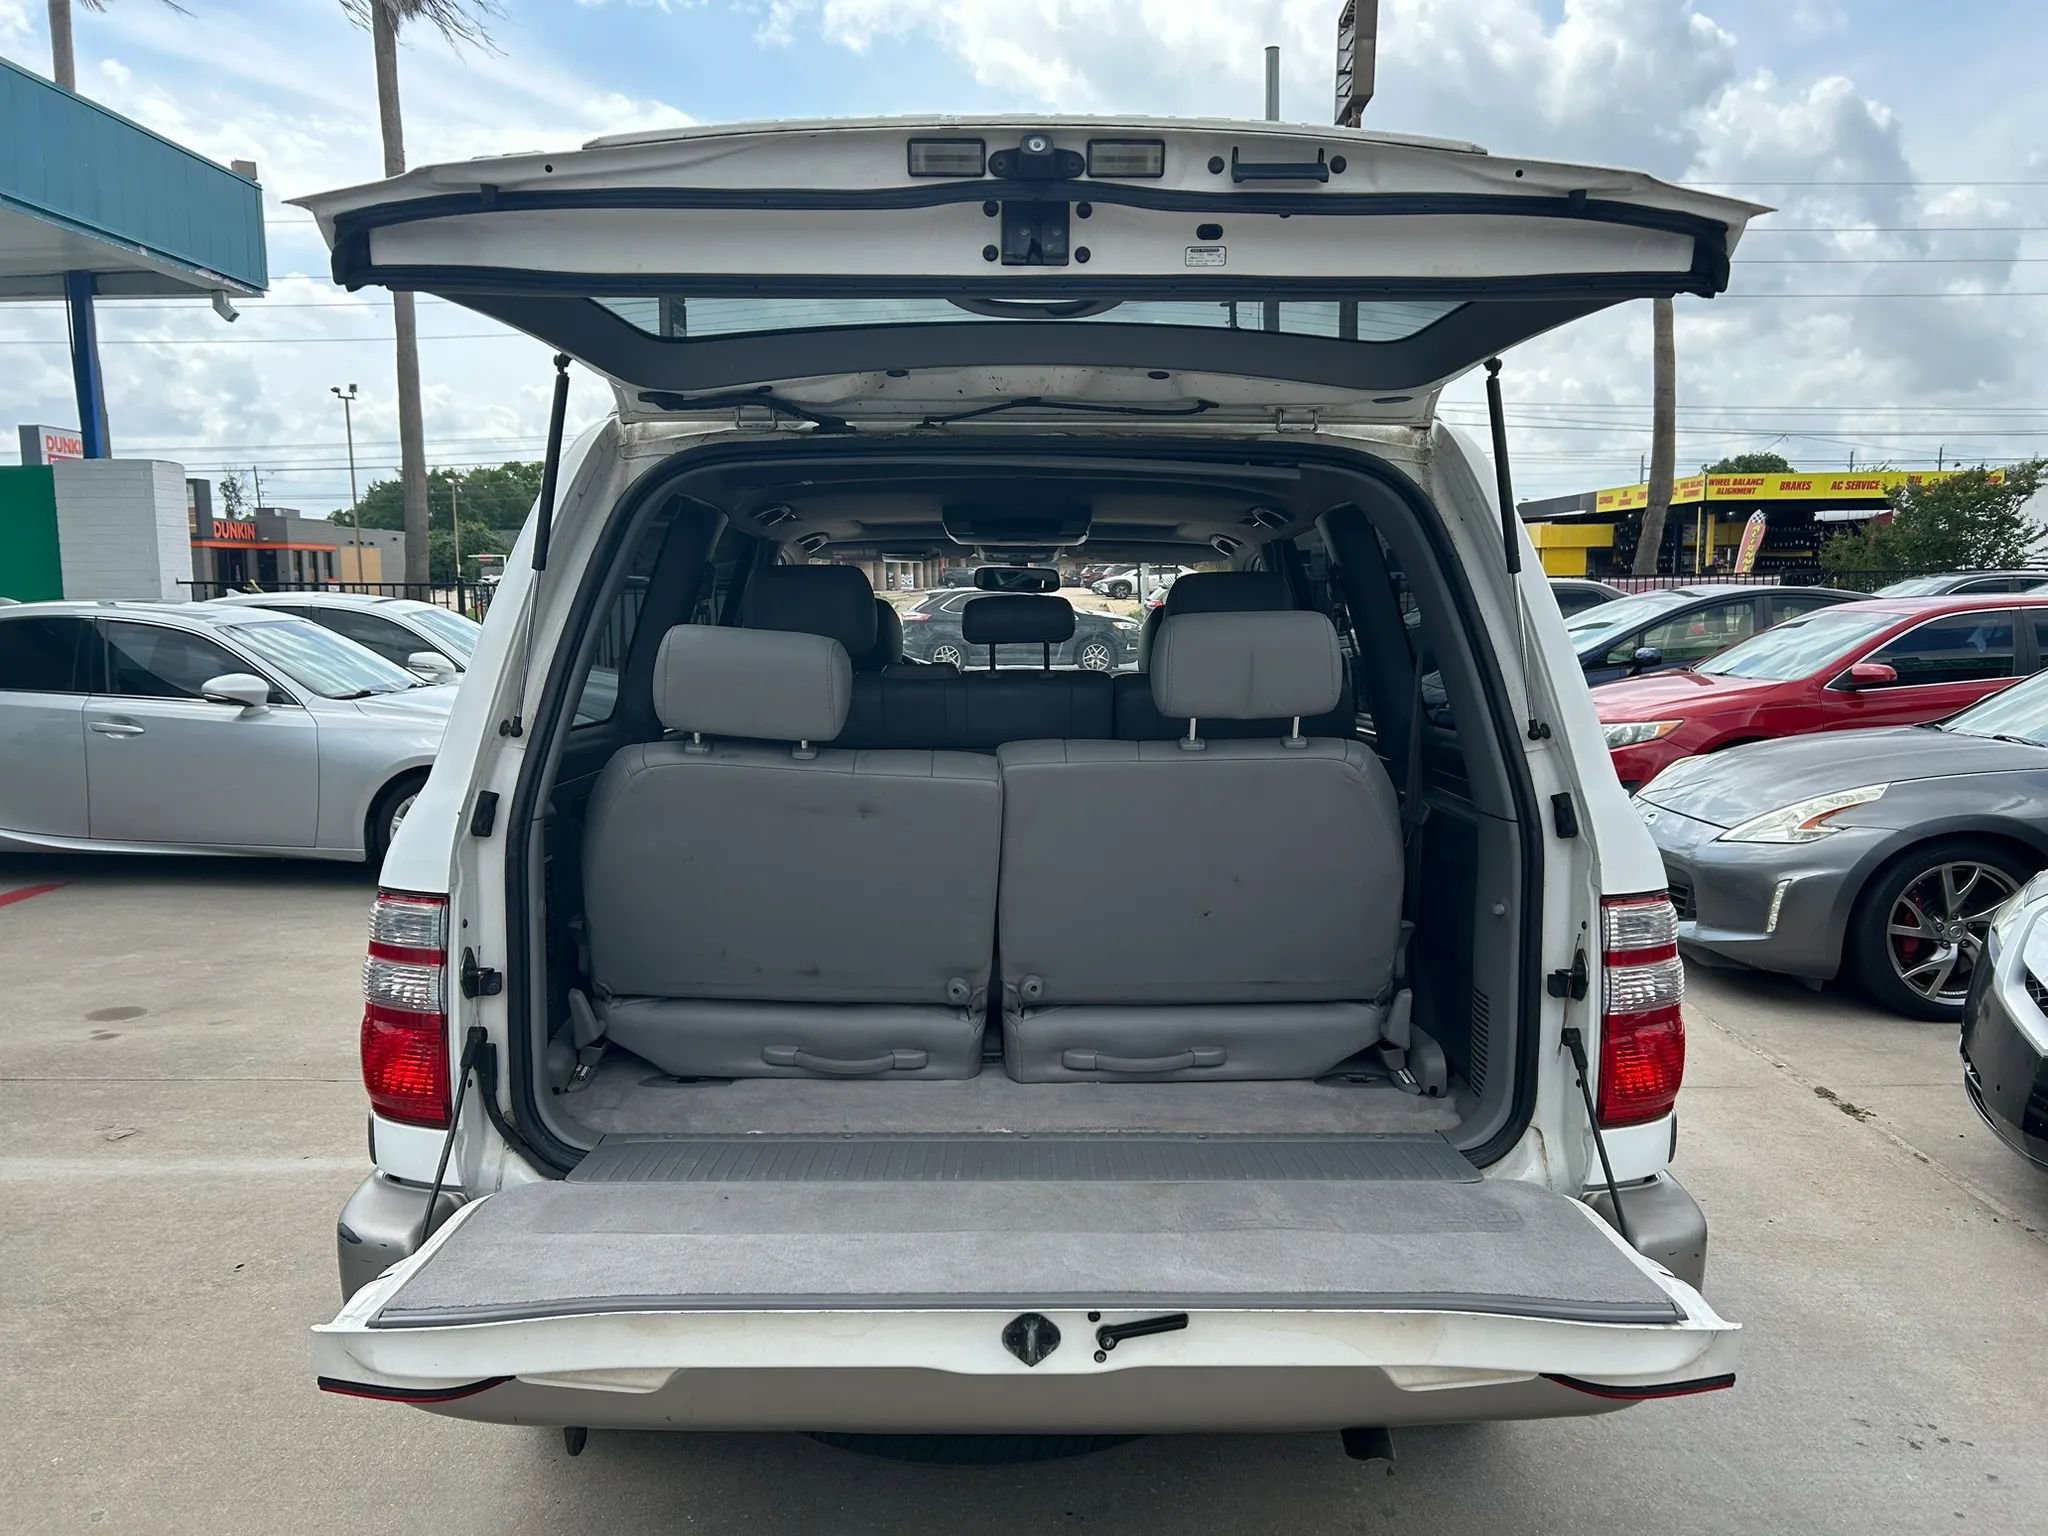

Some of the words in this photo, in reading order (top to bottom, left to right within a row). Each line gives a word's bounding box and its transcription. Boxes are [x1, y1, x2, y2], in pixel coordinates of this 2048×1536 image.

[1708, 478, 1731, 486] WHEEL
[1732, 478, 1765, 486] BALANCE
[1779, 480, 1812, 490] BRAKES
[1830, 480, 1844, 490] AC
[1845, 480, 1880, 490] SERVICE
[1715, 487, 1757, 495] ALIGNMENT
[213, 520, 256, 540] DUNKIN
